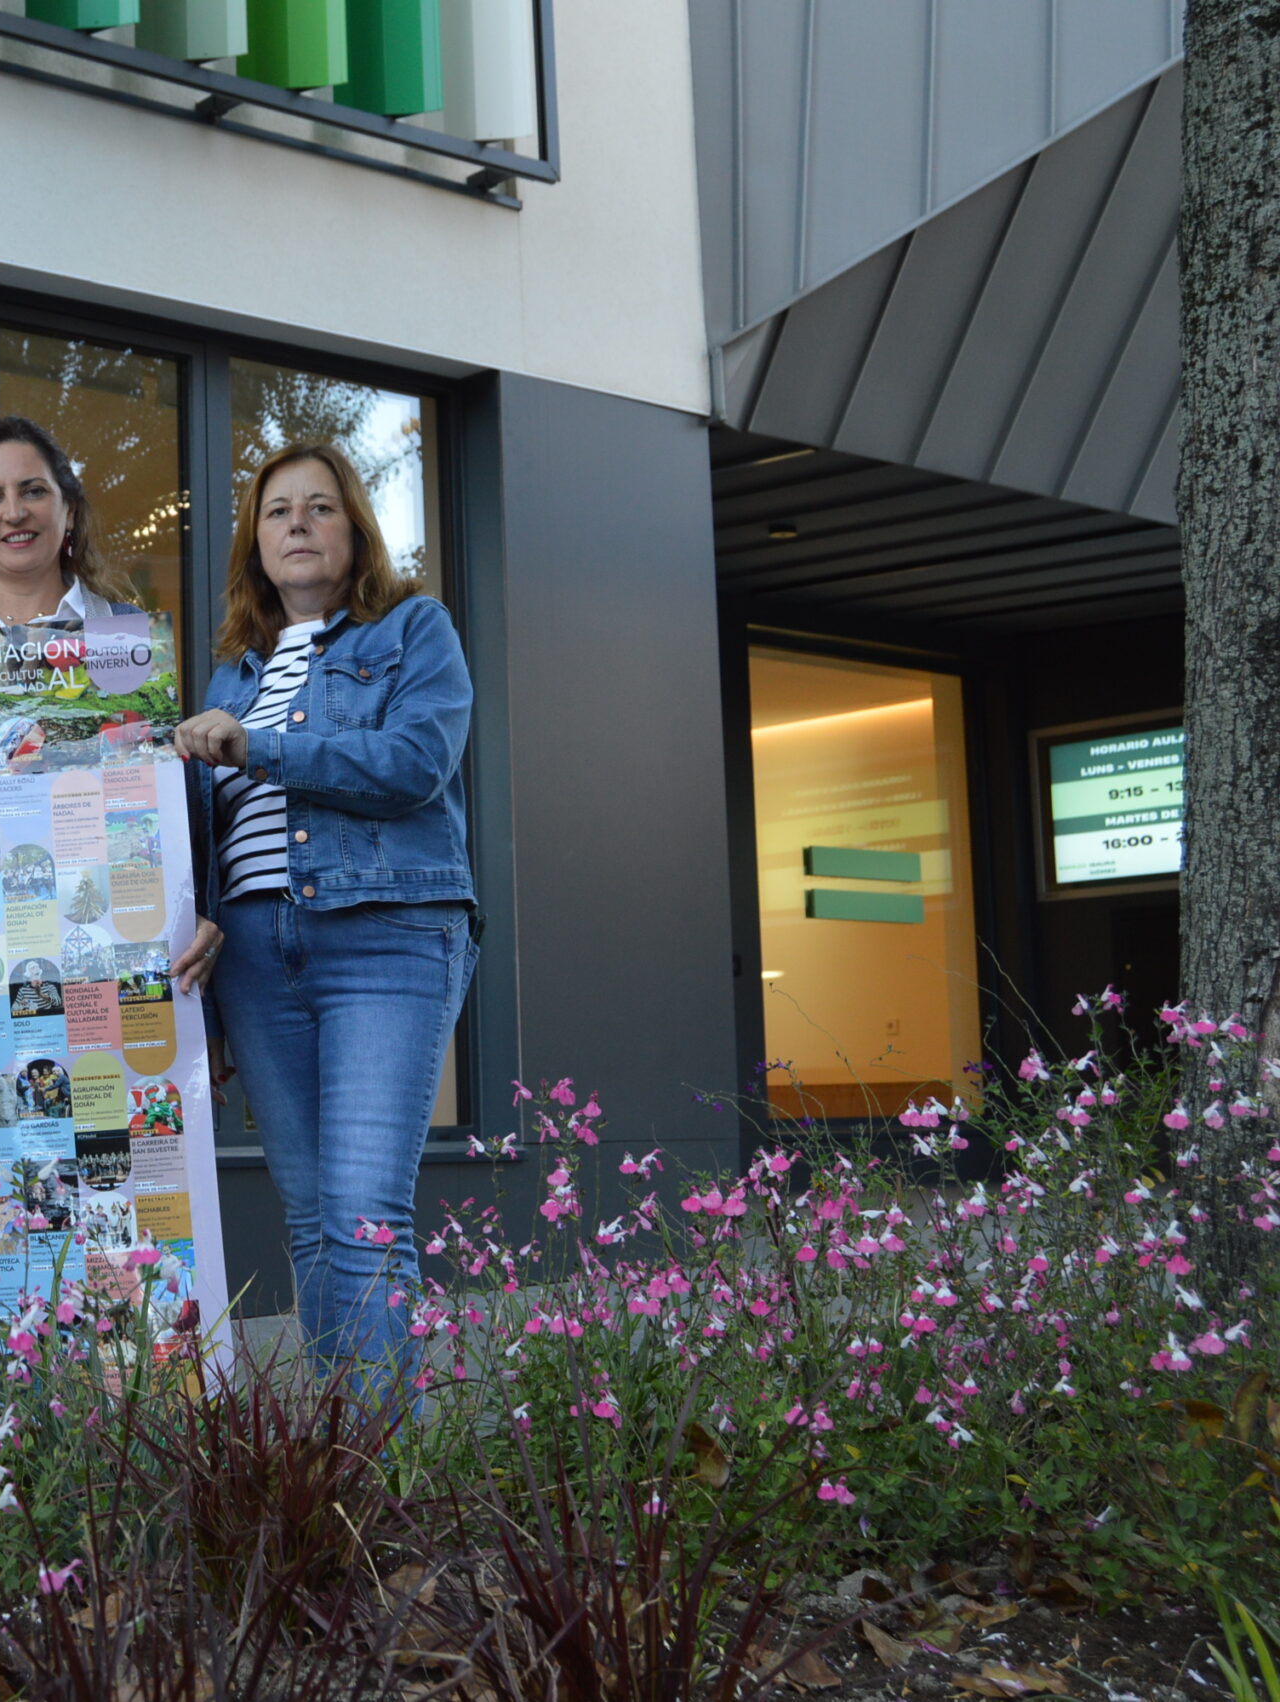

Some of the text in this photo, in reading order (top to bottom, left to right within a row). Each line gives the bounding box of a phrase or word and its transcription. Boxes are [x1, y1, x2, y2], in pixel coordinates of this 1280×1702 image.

[87, 658, 129, 670] INVERN
[0, 665, 85, 691] CULTUR AL
[1089, 739, 1149, 756] HORARIO
[1080, 763, 1115, 777] LUNS
[1127, 754, 1180, 770] VENRES
[1108, 785, 1144, 800] 9:15
[1104, 808, 1179, 827] MARTES DE
[1102, 835, 1153, 850] 16:00
[65, 986, 100, 994] RONDALLA
[76, 993, 103, 1001] CENTRO
[66, 1009, 99, 1017] CULTURAL
[121, 1012, 159, 1021] PERCUSIÓN
[67, 1015, 108, 1024] VALLADARES
[72, 1084, 115, 1093] AGRUPACIÓN
[73, 1093, 102, 1101] MUSICAL
[30, 1120, 60, 1129] GARDIÁS
[136, 1139, 169, 1147] CARREIRA
[132, 1145, 179, 1155] SAN SILVESTRE
